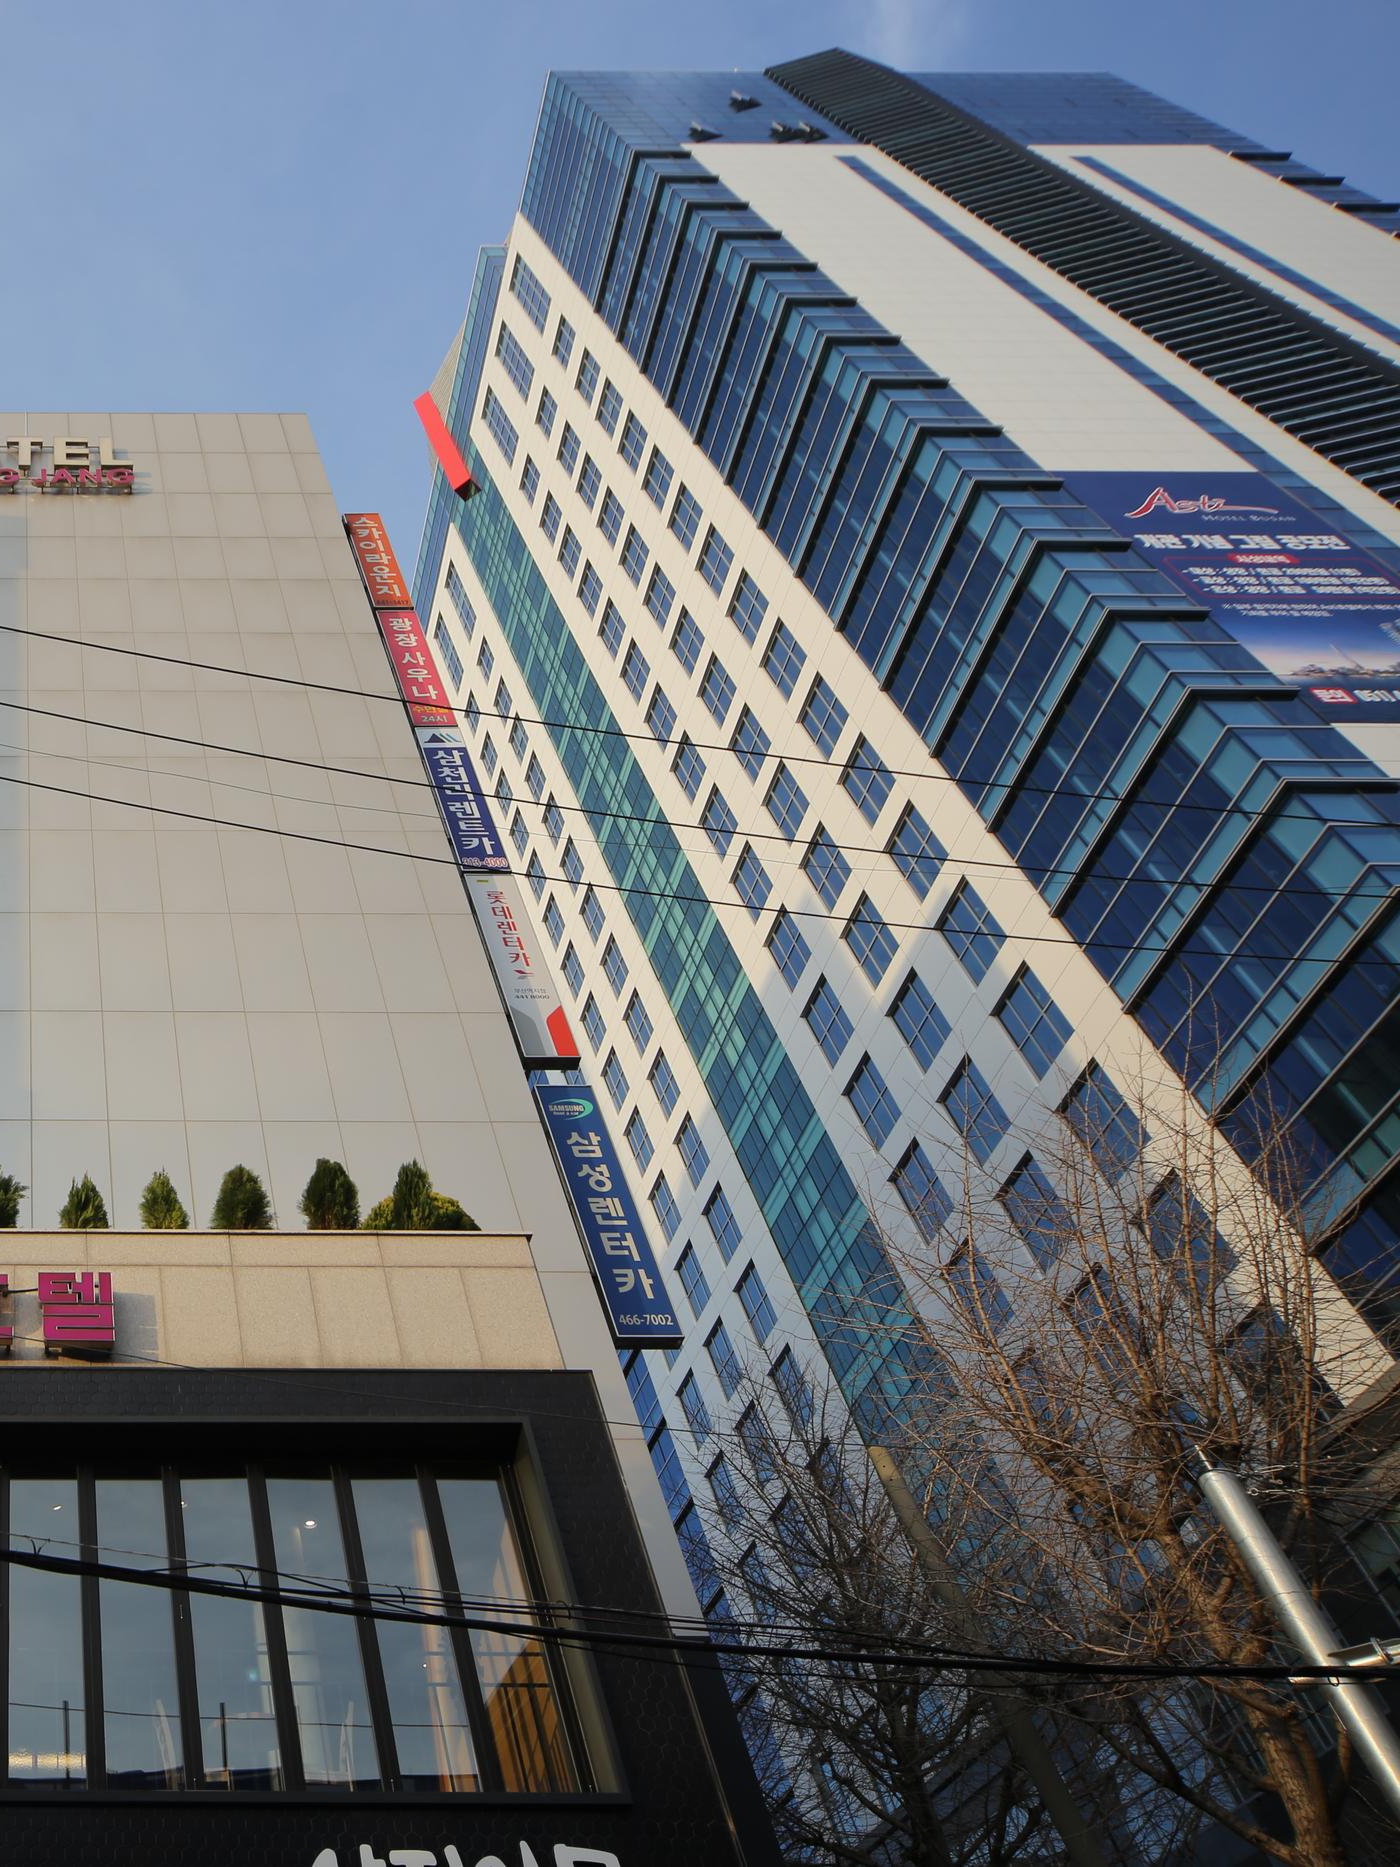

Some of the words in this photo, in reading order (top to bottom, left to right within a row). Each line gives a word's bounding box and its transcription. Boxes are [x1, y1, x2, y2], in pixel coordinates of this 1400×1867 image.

[31, 468, 136, 486] JANG
[352, 517, 402, 597] 스카이라운지
[389, 618, 419, 647] 광장
[402, 652, 439, 699] 사우나
[433, 750, 495, 855] 삼천리렌트카
[487, 891, 532, 967] 롯데렌터카
[566, 1132, 654, 1299] 삼성렌터카
[619, 1314, 674, 1326] 466-7002
